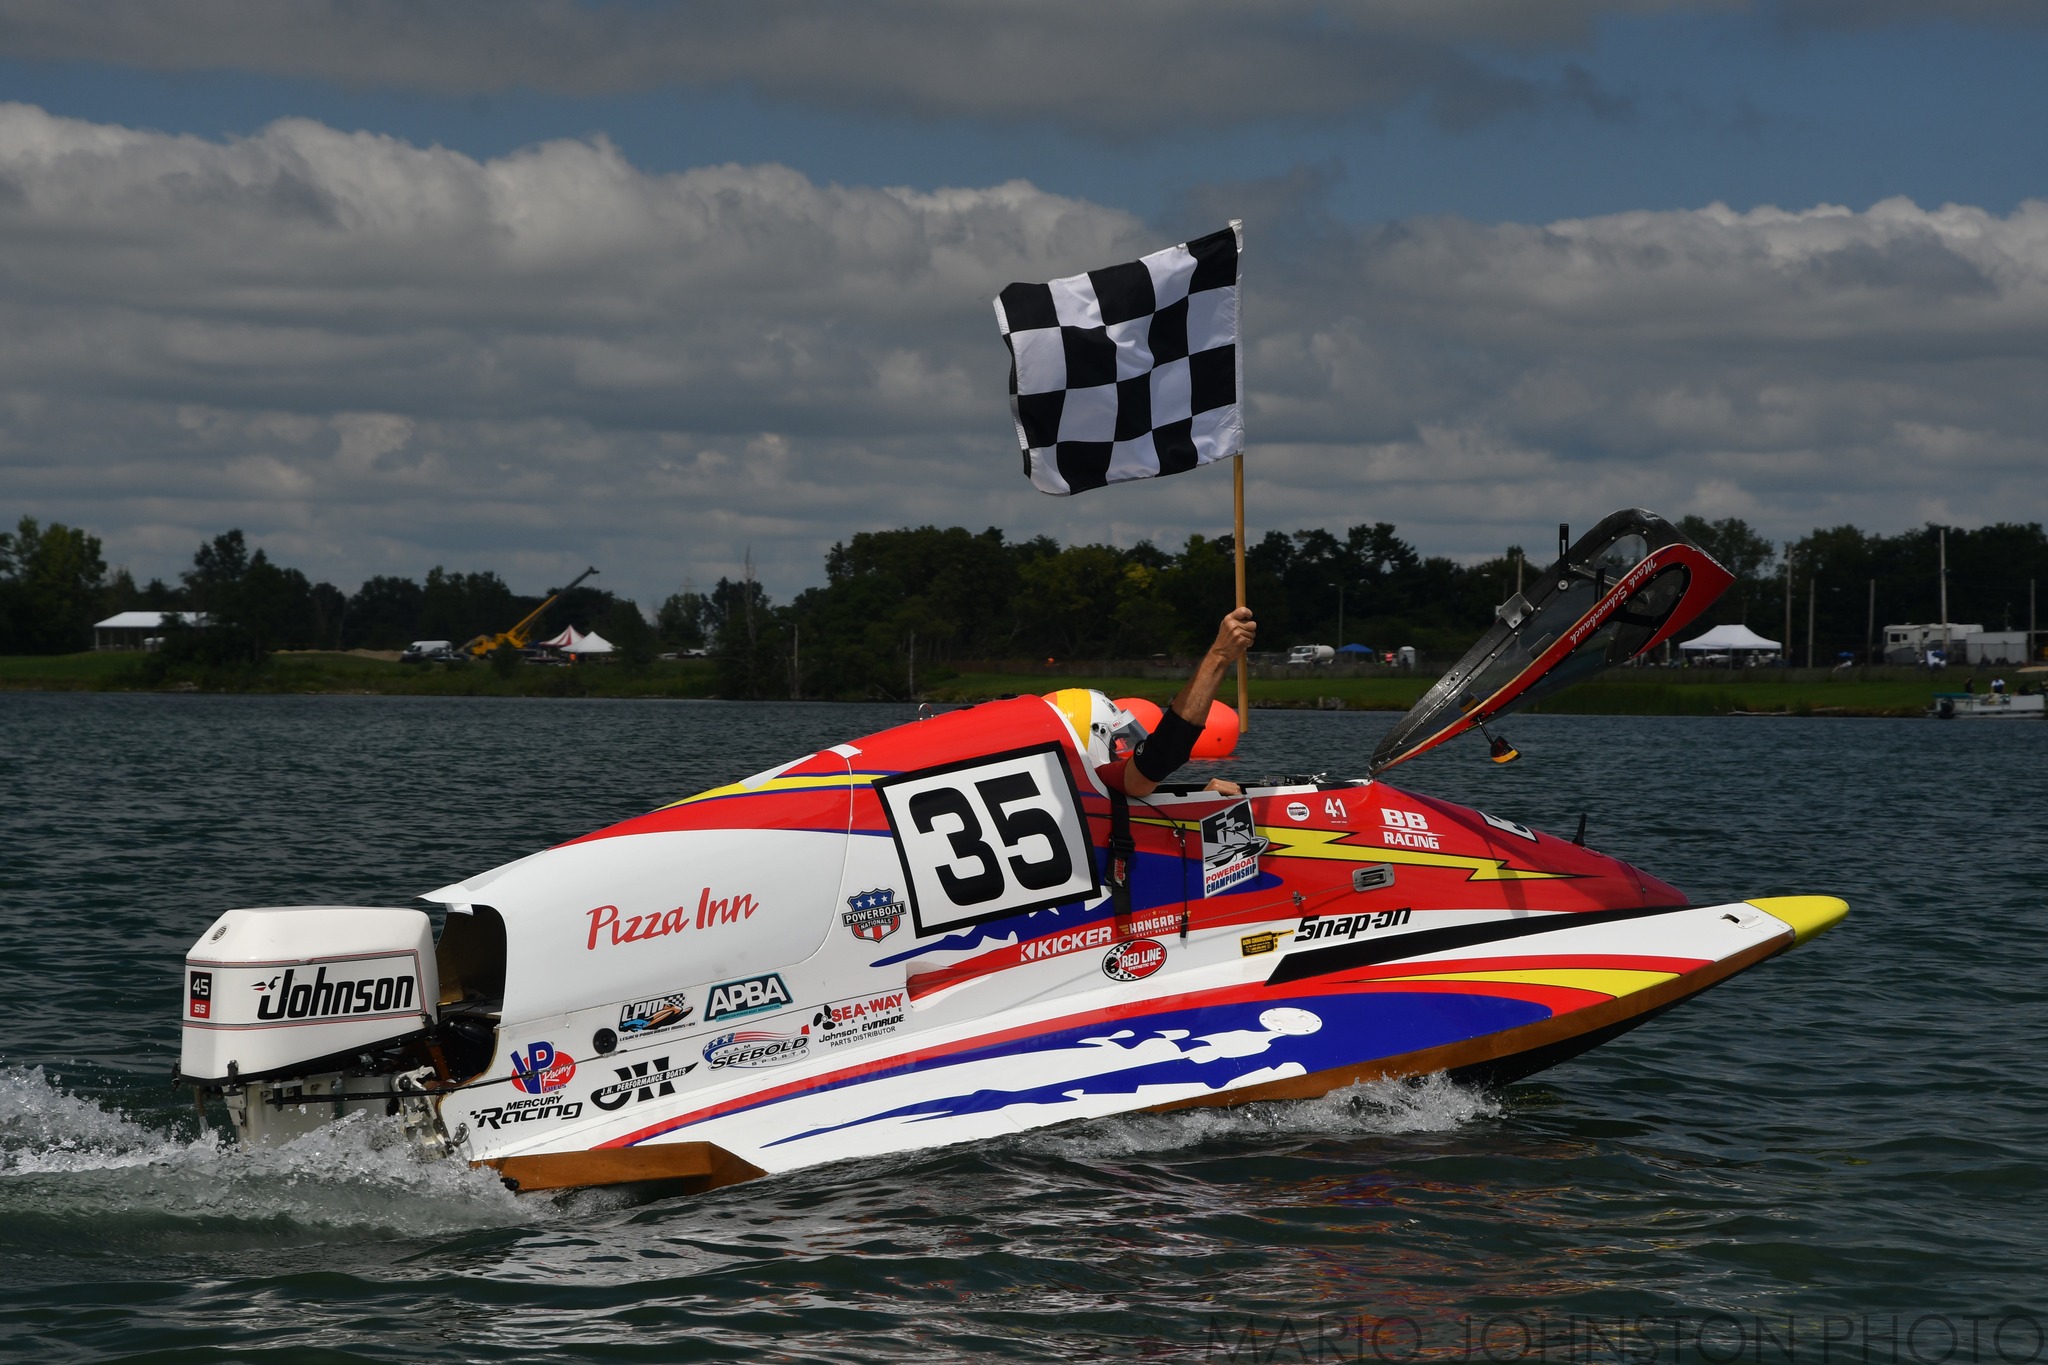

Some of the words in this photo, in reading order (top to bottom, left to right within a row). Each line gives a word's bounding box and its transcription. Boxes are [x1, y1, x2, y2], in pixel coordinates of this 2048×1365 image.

[1628, 559, 1657, 588] Mark
[1569, 585, 1628, 645] Schmerbauch
[1325, 798, 1347, 818] 41
[1380, 808, 1429, 830] BB
[908, 771, 1073, 906] 35
[1383, 832, 1440, 849] RACING
[1206, 856, 1256, 884] POWERBOAT
[1206, 864, 1257, 894] CHAMPIONSHIP
[586, 904, 690, 950] Pizza
[696, 887, 759, 930] Inn
[845, 905, 902, 923] POWERBOAT
[860, 919, 892, 930] NATIONALS
[1129, 915, 1175, 934] HANGAR
[1294, 907, 1412, 943] Snap-on
[1037, 926, 1112, 959] KICKER
[1121, 954, 1139, 968] RED
[1141, 947, 1162, 963] LINE
[193, 978, 209, 995] 45
[257, 966, 415, 1020] Johnson
[709, 977, 788, 1017] APBA
[194, 1003, 206, 1014] SS
[831, 993, 903, 1022] SEA-WAY
[838, 1007, 903, 1027] MARINE
[819, 1028, 858, 1043] Johnson
[862, 1014, 904, 1032] EVINRUDE
[831, 1035, 852, 1048] PARTS
[853, 1026, 896, 1042] DISTRIBUTOR
[711, 1037, 808, 1070] SEEBOLD
[715, 1044, 751, 1056] TEAM
[751, 1049, 807, 1066] SPORTS
[510, 1041, 555, 1094] VP
[541, 1063, 574, 1087] Racing
[600, 1086, 614, 1096] J.H.
[617, 1074, 664, 1091] PERFORMANCE
[666, 1067, 687, 1079] BOATS
[477, 1102, 583, 1130] Racing
[506, 1095, 563, 1110] MERCURY
